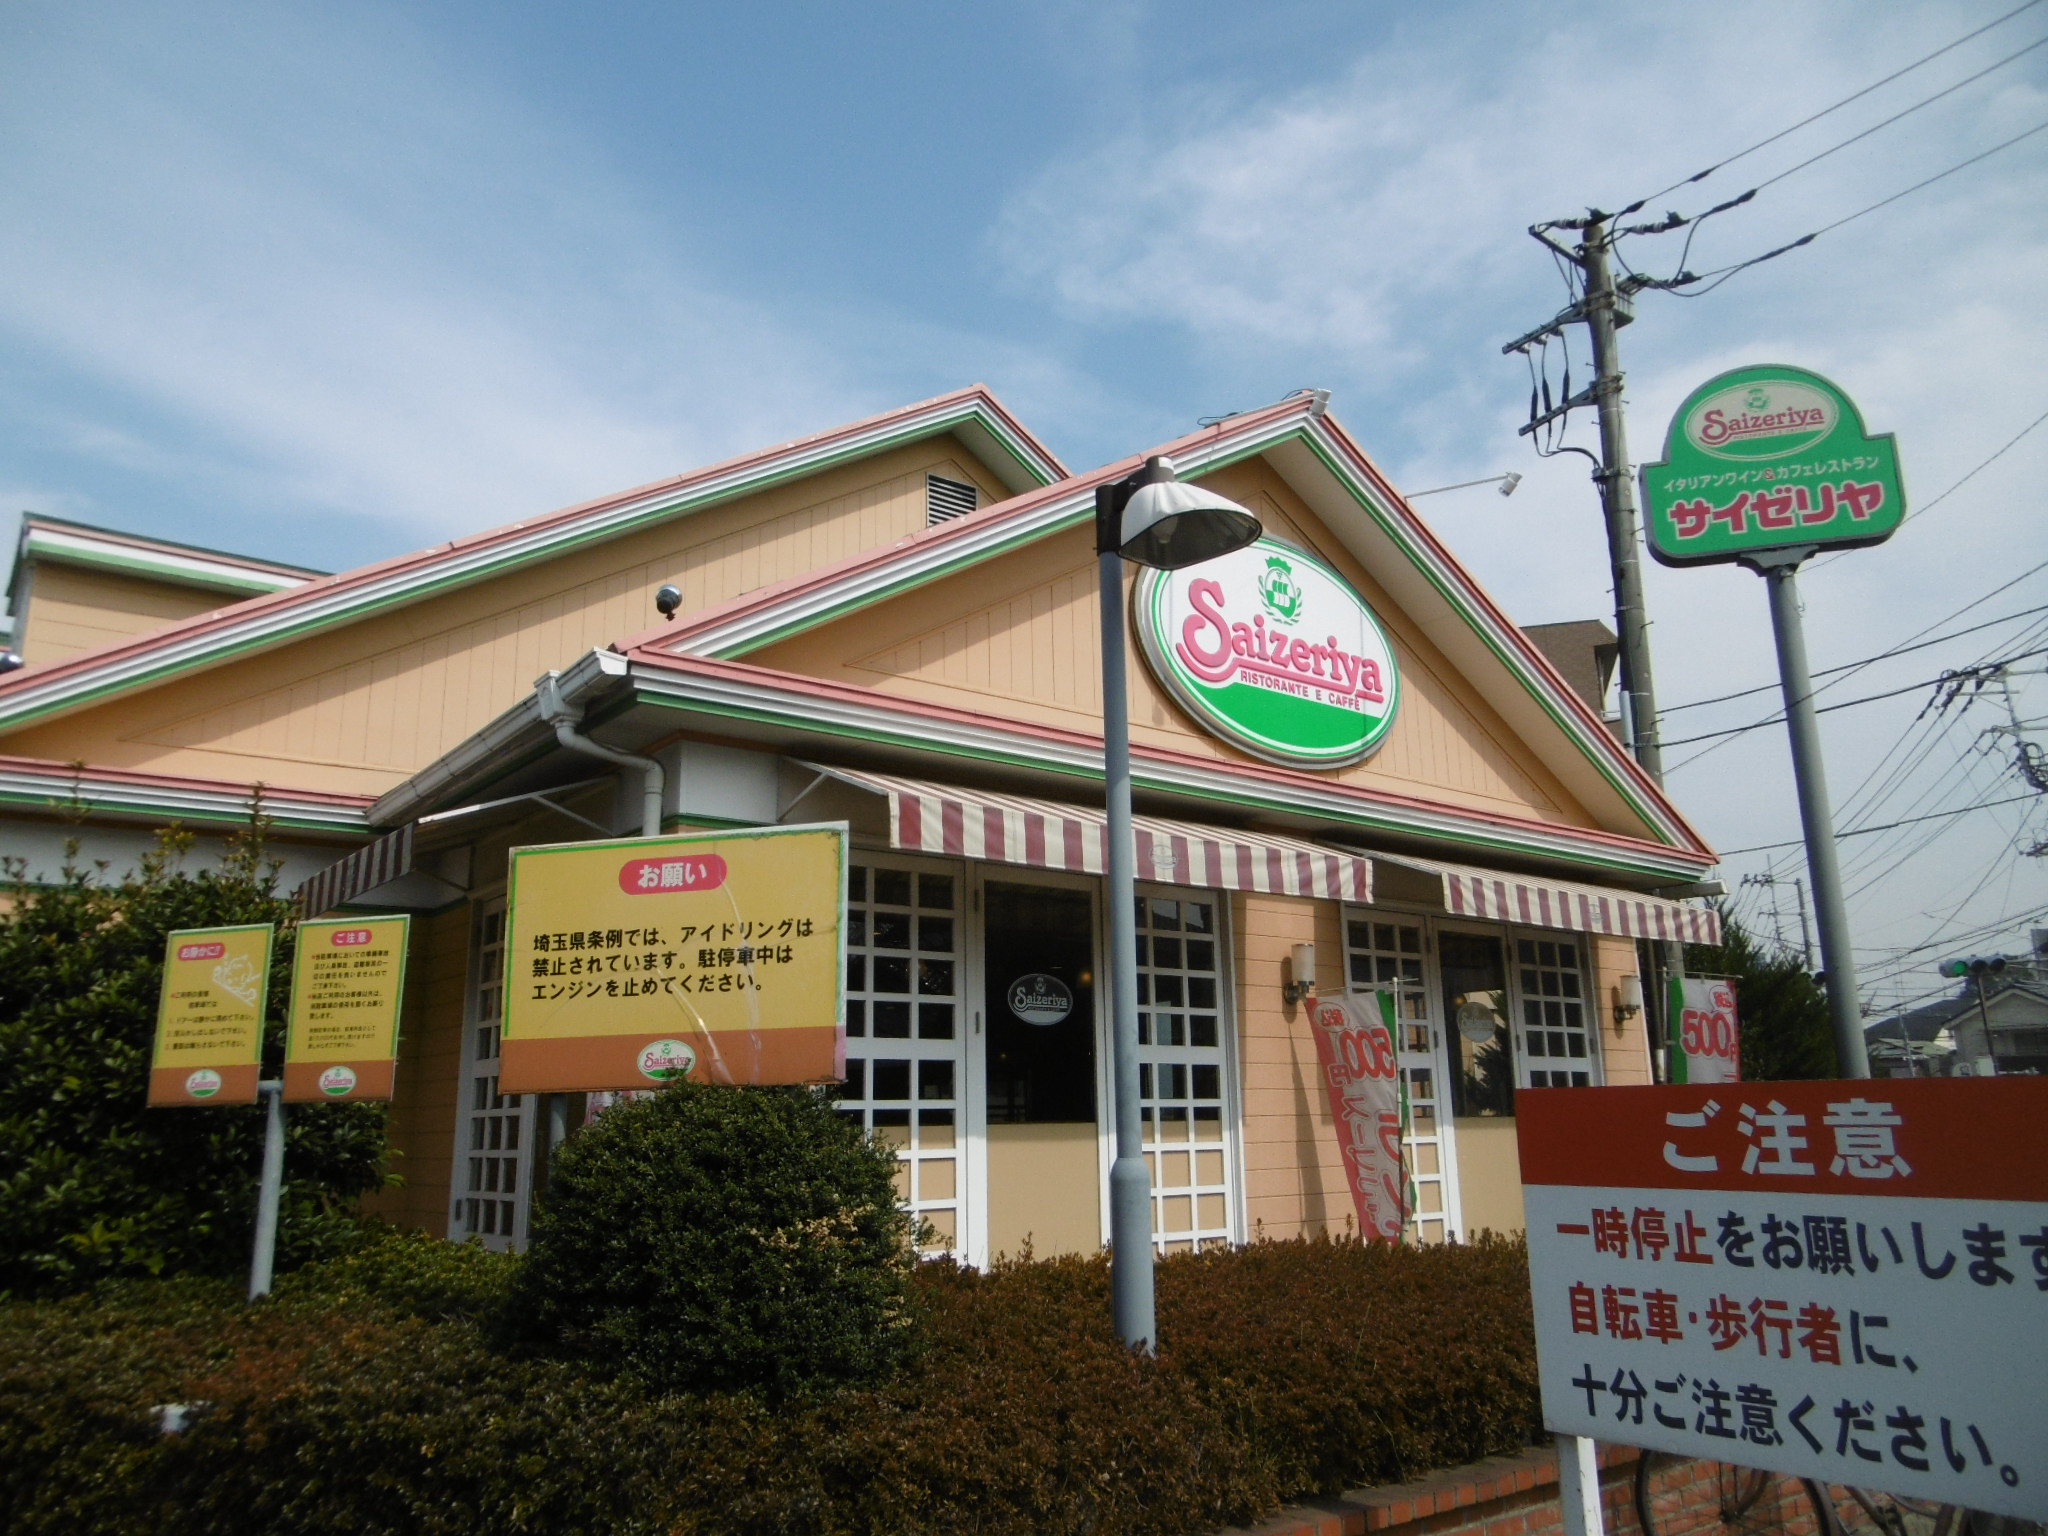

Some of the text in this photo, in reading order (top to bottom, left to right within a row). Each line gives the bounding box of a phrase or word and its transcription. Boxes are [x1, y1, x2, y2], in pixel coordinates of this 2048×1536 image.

[1699, 407, 1824, 444] Saizeriya
[1667, 479, 1884, 539] サイゼリヤ
[1177, 578, 1384, 702] Saizeriya
[1240, 669, 1309, 697] RISTORANTE
[1315, 689, 1322, 701] E
[637, 862, 708, 888] お願い
[336, 932, 368, 944] ご注意
[533, 918, 814, 952] 埼玉県条例では、アイドリングは
[532, 945, 794, 978] 禁止されています。駐停車中は
[532, 973, 763, 1000] エンジンを止めてください。
[1014, 986, 1068, 1011] Saizeriya
[1662, 1098, 1913, 1178] ご注意
[1569, 1280, 1919, 1374] 自転車・歩行者に、
[1571, 1363, 2020, 1488] 十分ご注意ください。
